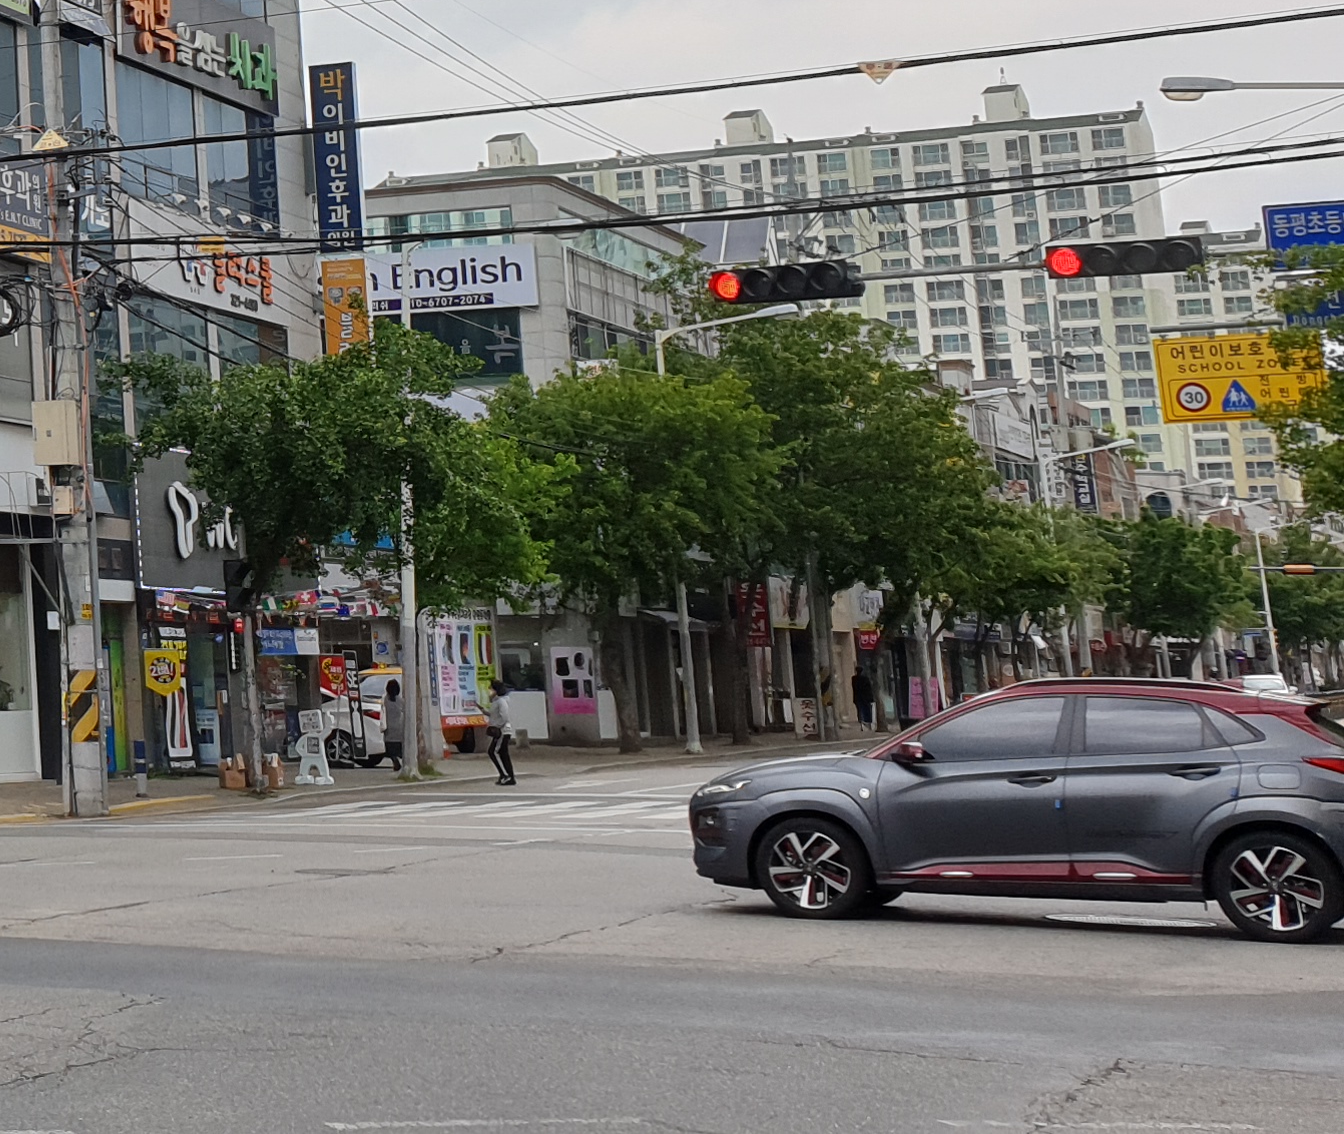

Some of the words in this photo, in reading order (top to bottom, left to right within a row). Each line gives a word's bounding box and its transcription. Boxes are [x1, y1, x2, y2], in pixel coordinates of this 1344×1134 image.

[226, 31, 278, 101] 치과
[22, 214, 42, 230] CLINIC
[392, 255, 522, 292] English
[410, 295, 486, 308] 10-6707-2074
[1178, 361, 1245, 373] SCHOOL
[1184, 392, 1204, 404] 30
